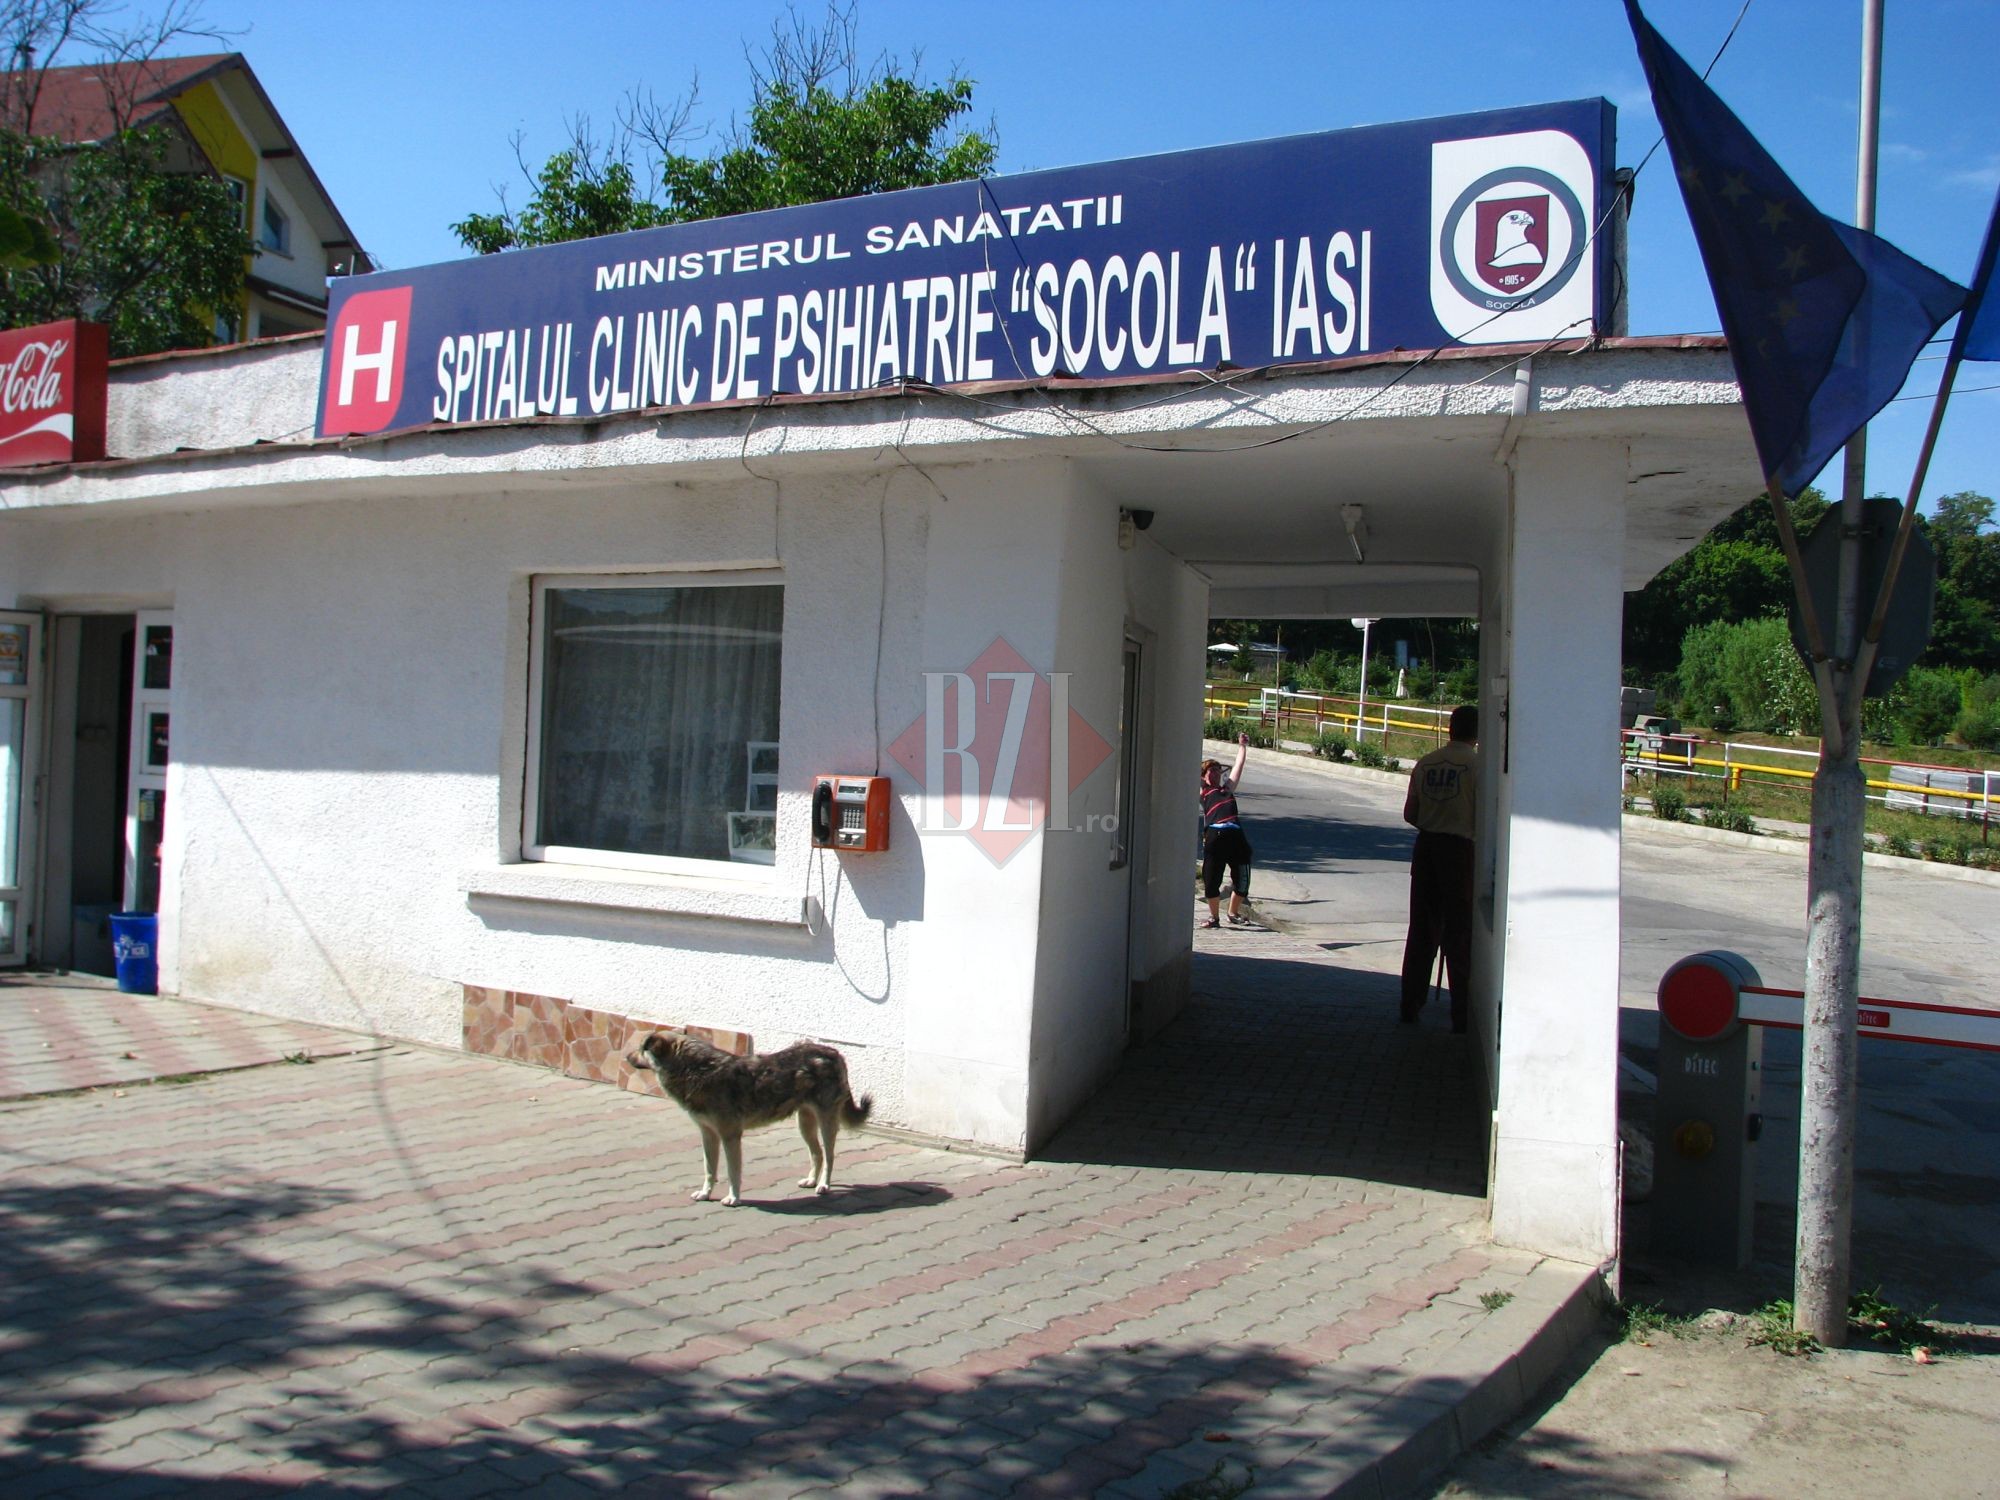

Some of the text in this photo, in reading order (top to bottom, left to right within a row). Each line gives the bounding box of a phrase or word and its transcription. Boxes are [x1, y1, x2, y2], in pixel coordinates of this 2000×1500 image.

[595, 194, 1123, 292] MINISTERUL SANATATII
[1504, 274, 1519, 286] 1905
[433, 322, 579, 422] SPITALUL
[589, 304, 703, 414] CLINIC
[711, 298, 764, 402] DE
[772, 271, 997, 395] PSIHIATRIE
[1273, 230, 1372, 358] IASI
[1485, 298, 1536, 310] SOCOLA
[338, 319, 398, 407] H
